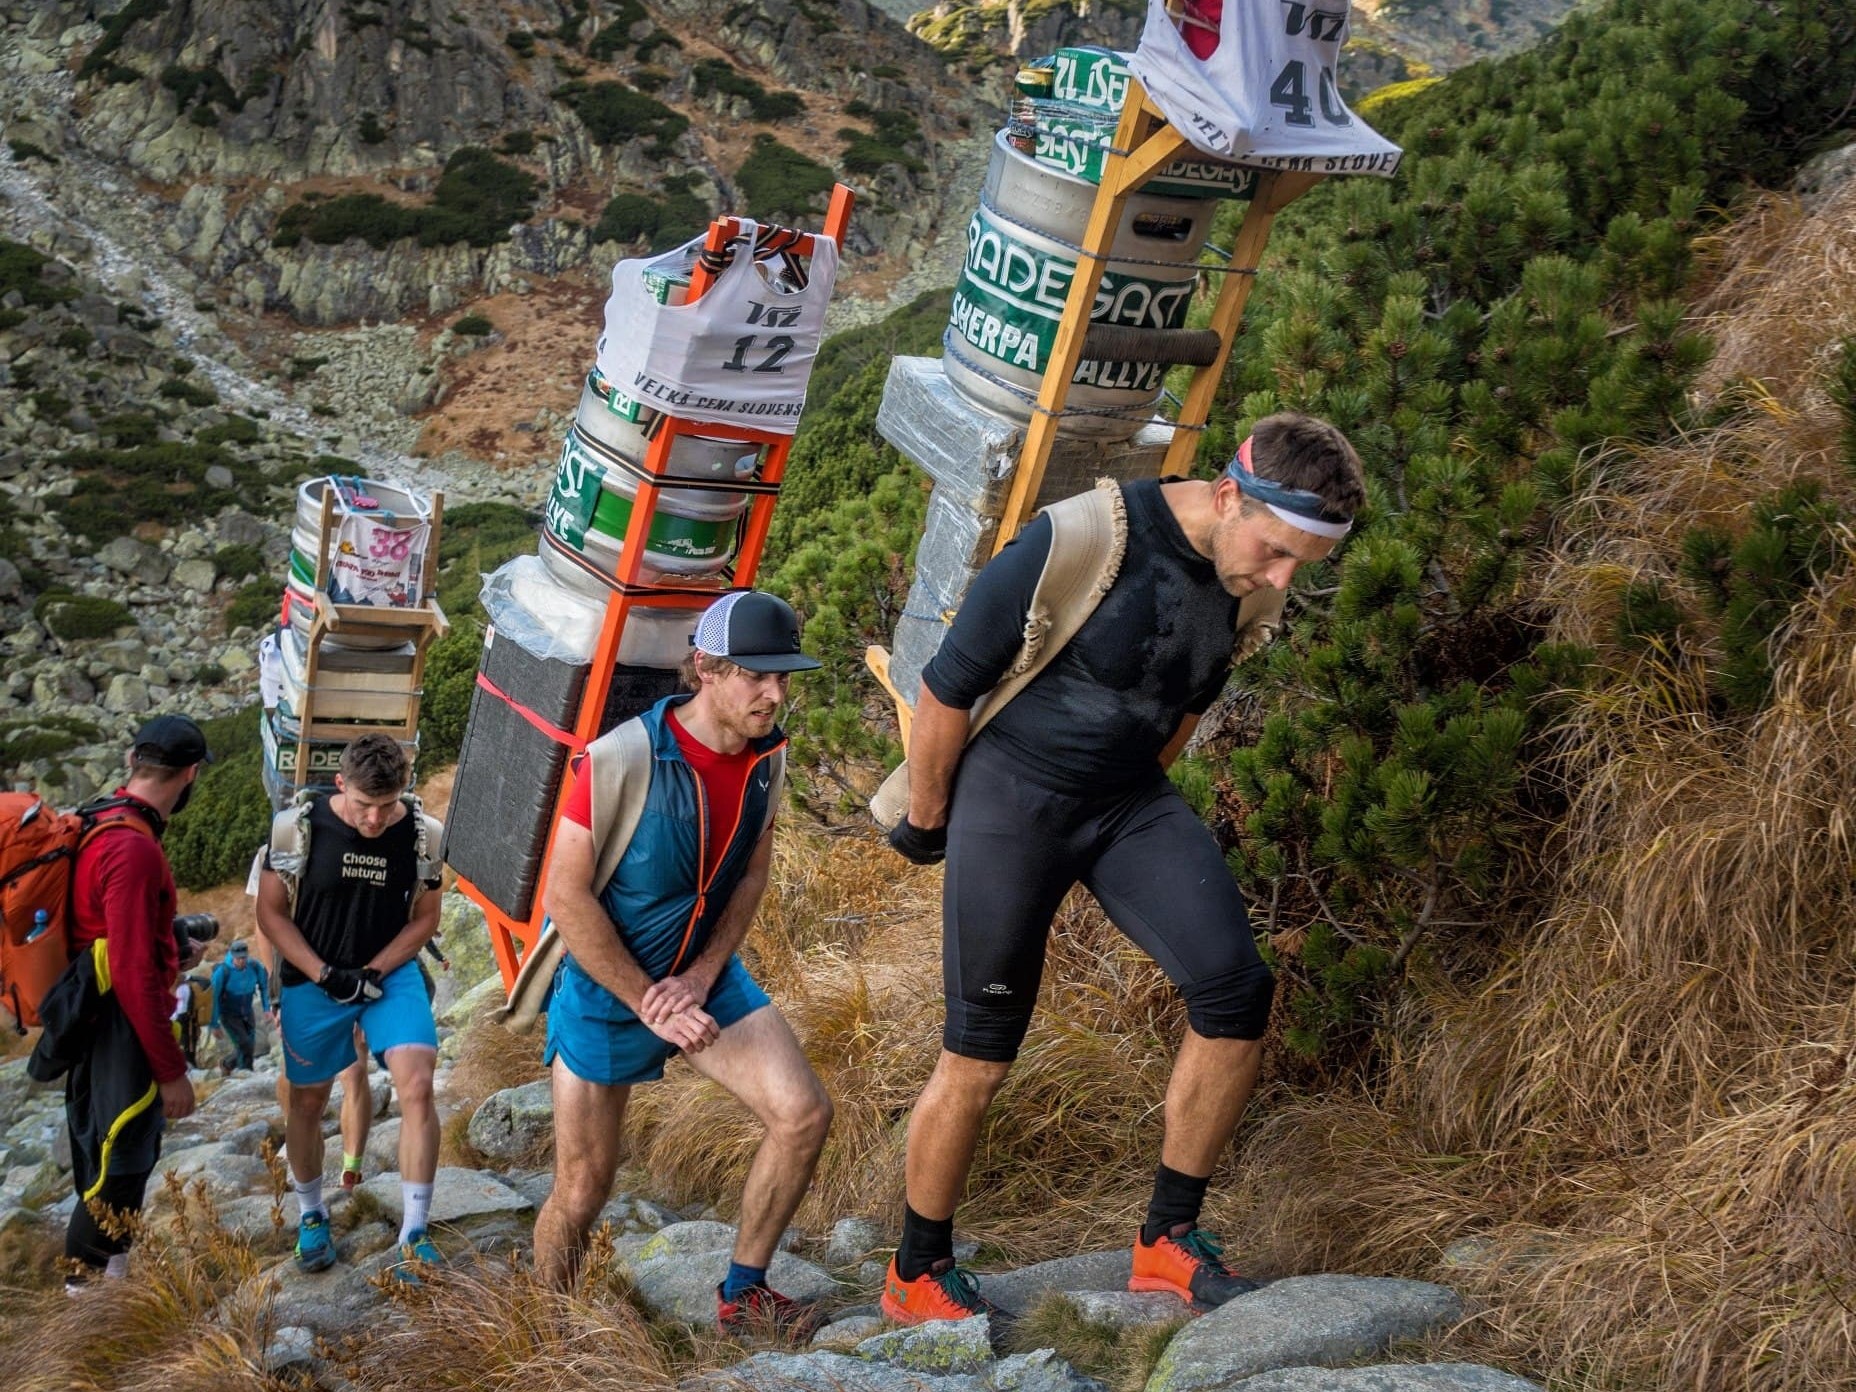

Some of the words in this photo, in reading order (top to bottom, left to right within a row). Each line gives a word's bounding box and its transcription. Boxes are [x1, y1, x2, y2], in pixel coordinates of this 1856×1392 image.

[1269, 60, 1353, 128] 40
[721, 334, 796, 375] 12
[949, 291, 1039, 371] SHERPA
[1072, 360, 1161, 390] ALLYE
[697, 396, 736, 412] CENA
[342, 866, 387, 881] Natural
[343, 852, 387, 868] Choose
